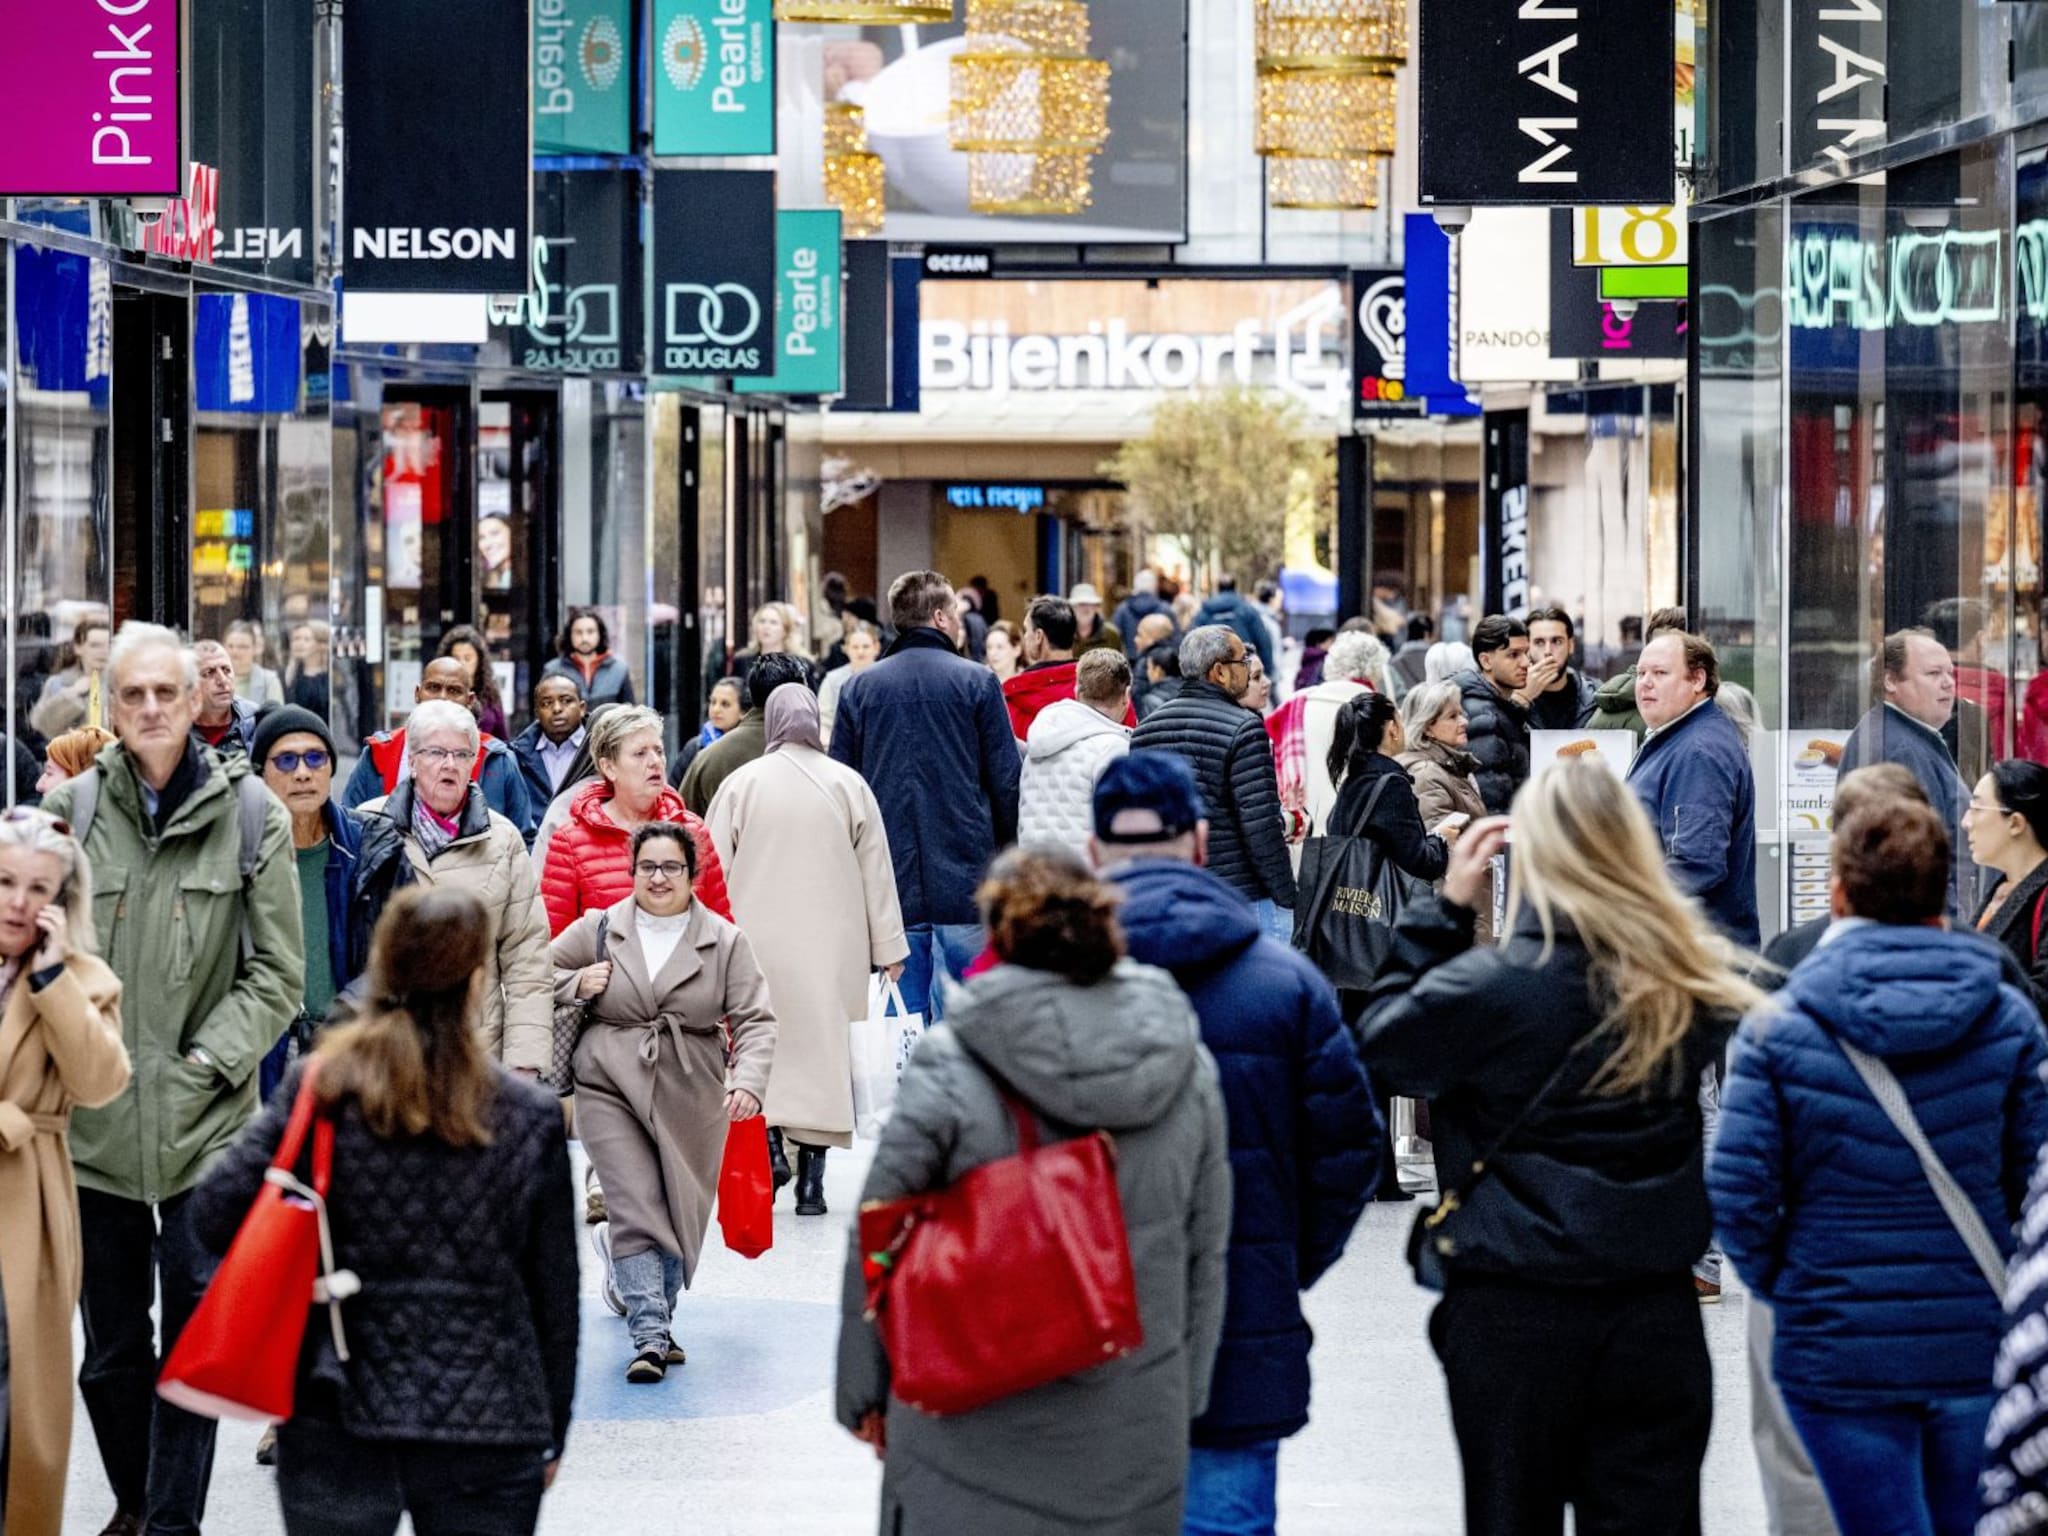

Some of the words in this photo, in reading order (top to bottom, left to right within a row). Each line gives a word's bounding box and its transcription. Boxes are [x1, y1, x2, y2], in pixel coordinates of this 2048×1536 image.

[353, 227, 516, 259] NELSON
[927, 254, 988, 272] OCEAN
[786, 248, 817, 356] Pearle
[665, 347, 760, 369] DOUGLAS
[919, 317, 1260, 401] Bijenkorf
[1332, 898, 1381, 919] MAISON
